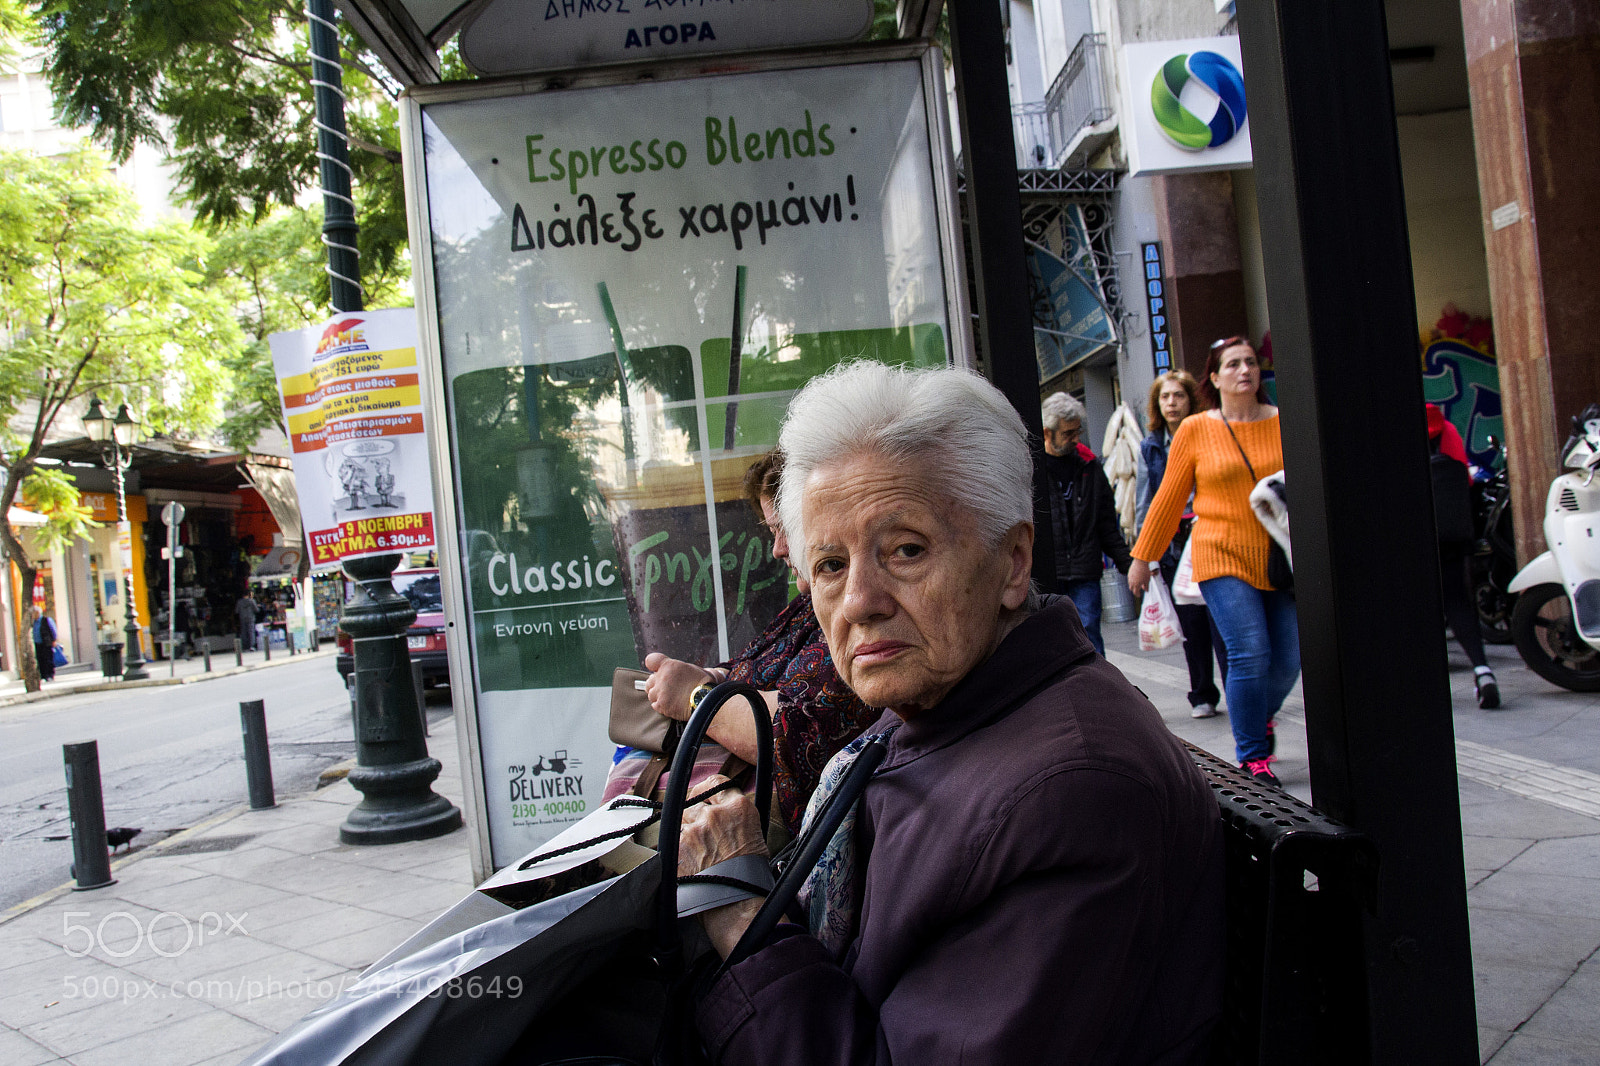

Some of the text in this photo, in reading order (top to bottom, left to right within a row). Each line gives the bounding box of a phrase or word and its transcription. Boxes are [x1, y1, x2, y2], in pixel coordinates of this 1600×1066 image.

[624, 21, 716, 49] ΑΓΟΡΑ
[525, 109, 835, 195] Espresso Blends
[511, 174, 859, 252] Διάλεξε χαρμάνι!
[1145, 244, 1170, 376] ΑΠΟΡΡΥΠ
[356, 362, 381, 373] ευρώ
[354, 377, 397, 391] μισθούς
[358, 398, 401, 413] δικαίωμα
[346, 522, 355, 536] 9
[357, 513, 423, 534] ΝΟΕΜΒΡΗ
[377, 534, 431, 548] 6.30μ.μ.
[487, 552, 616, 597] Classic
[492, 614, 609, 638] Έντονη γεύση
[508, 764, 526, 781] my
[510, 775, 583, 802] DELIVERY
